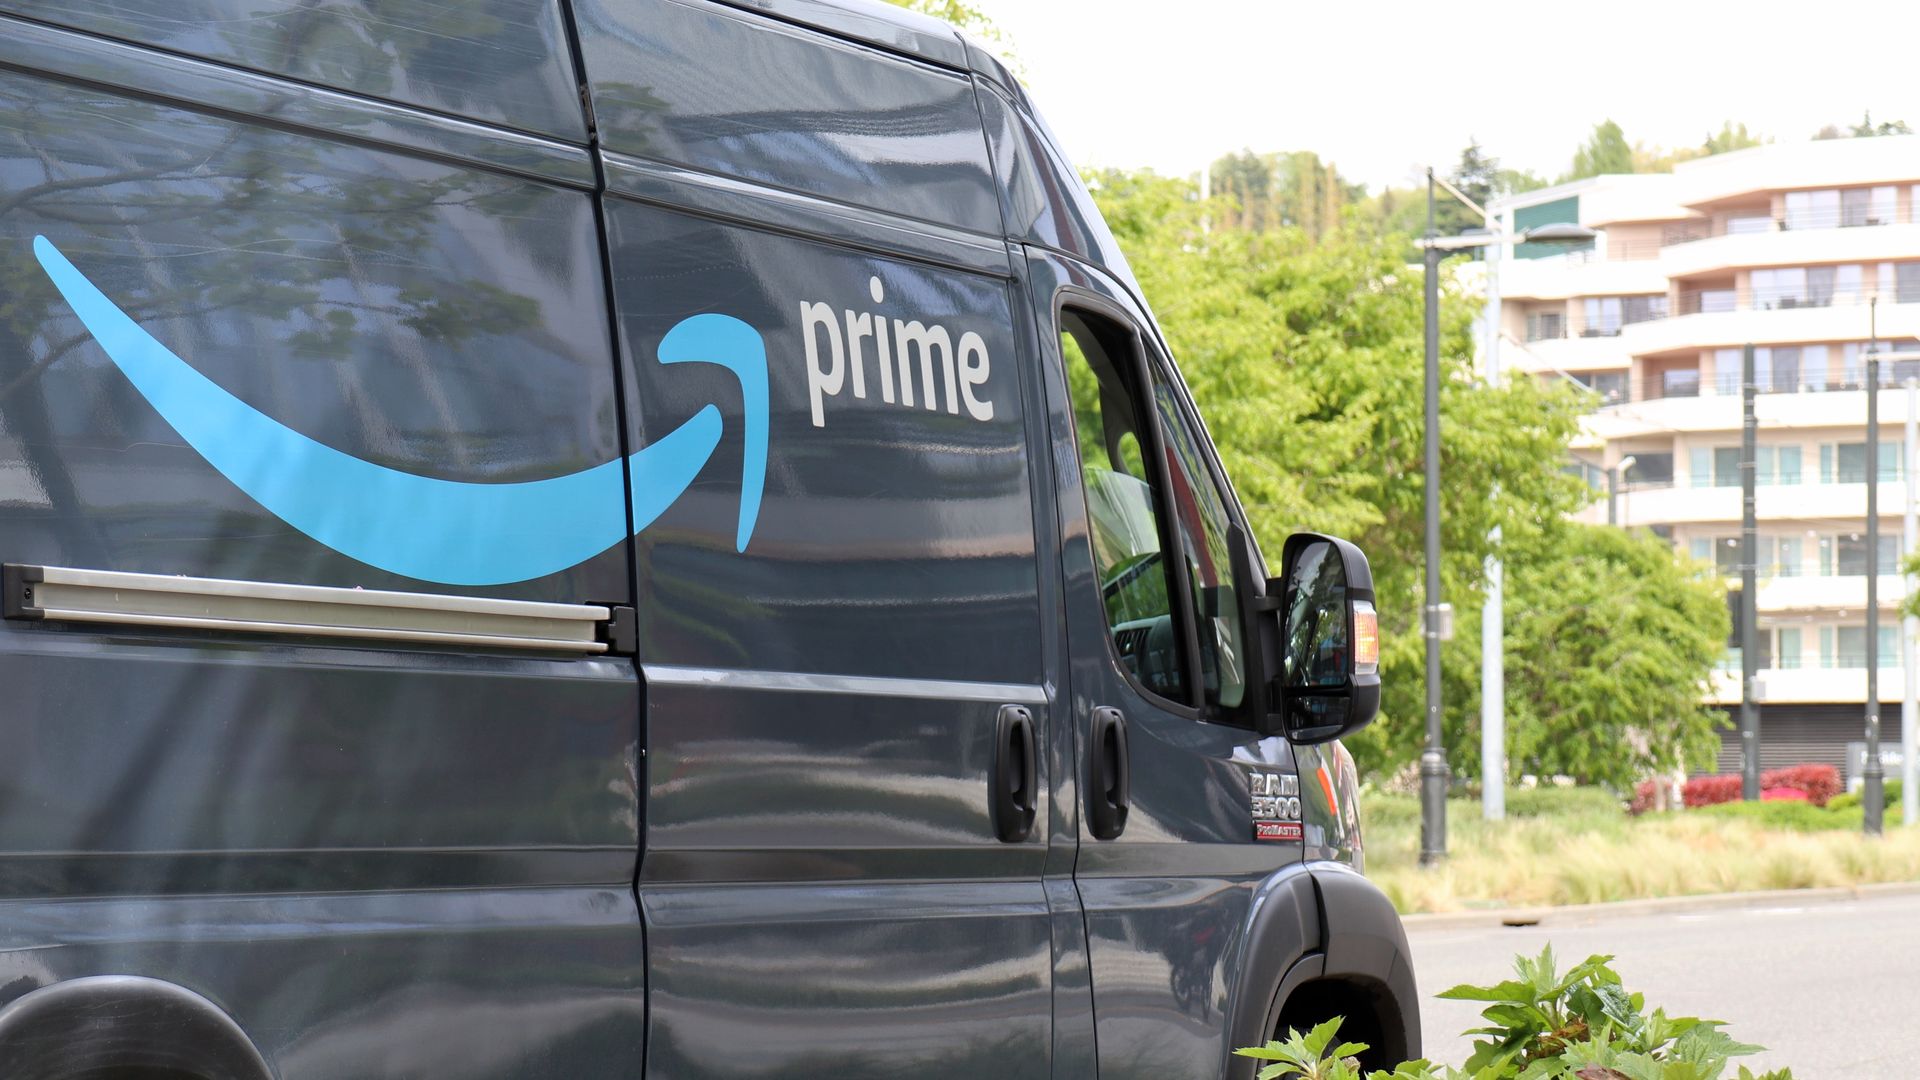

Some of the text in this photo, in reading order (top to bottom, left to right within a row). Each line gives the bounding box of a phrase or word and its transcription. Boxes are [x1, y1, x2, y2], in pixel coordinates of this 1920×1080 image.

[800, 276, 994, 427] prime
[1249, 773, 1299, 795] RAM
[1251, 796, 1301, 819] 3500
